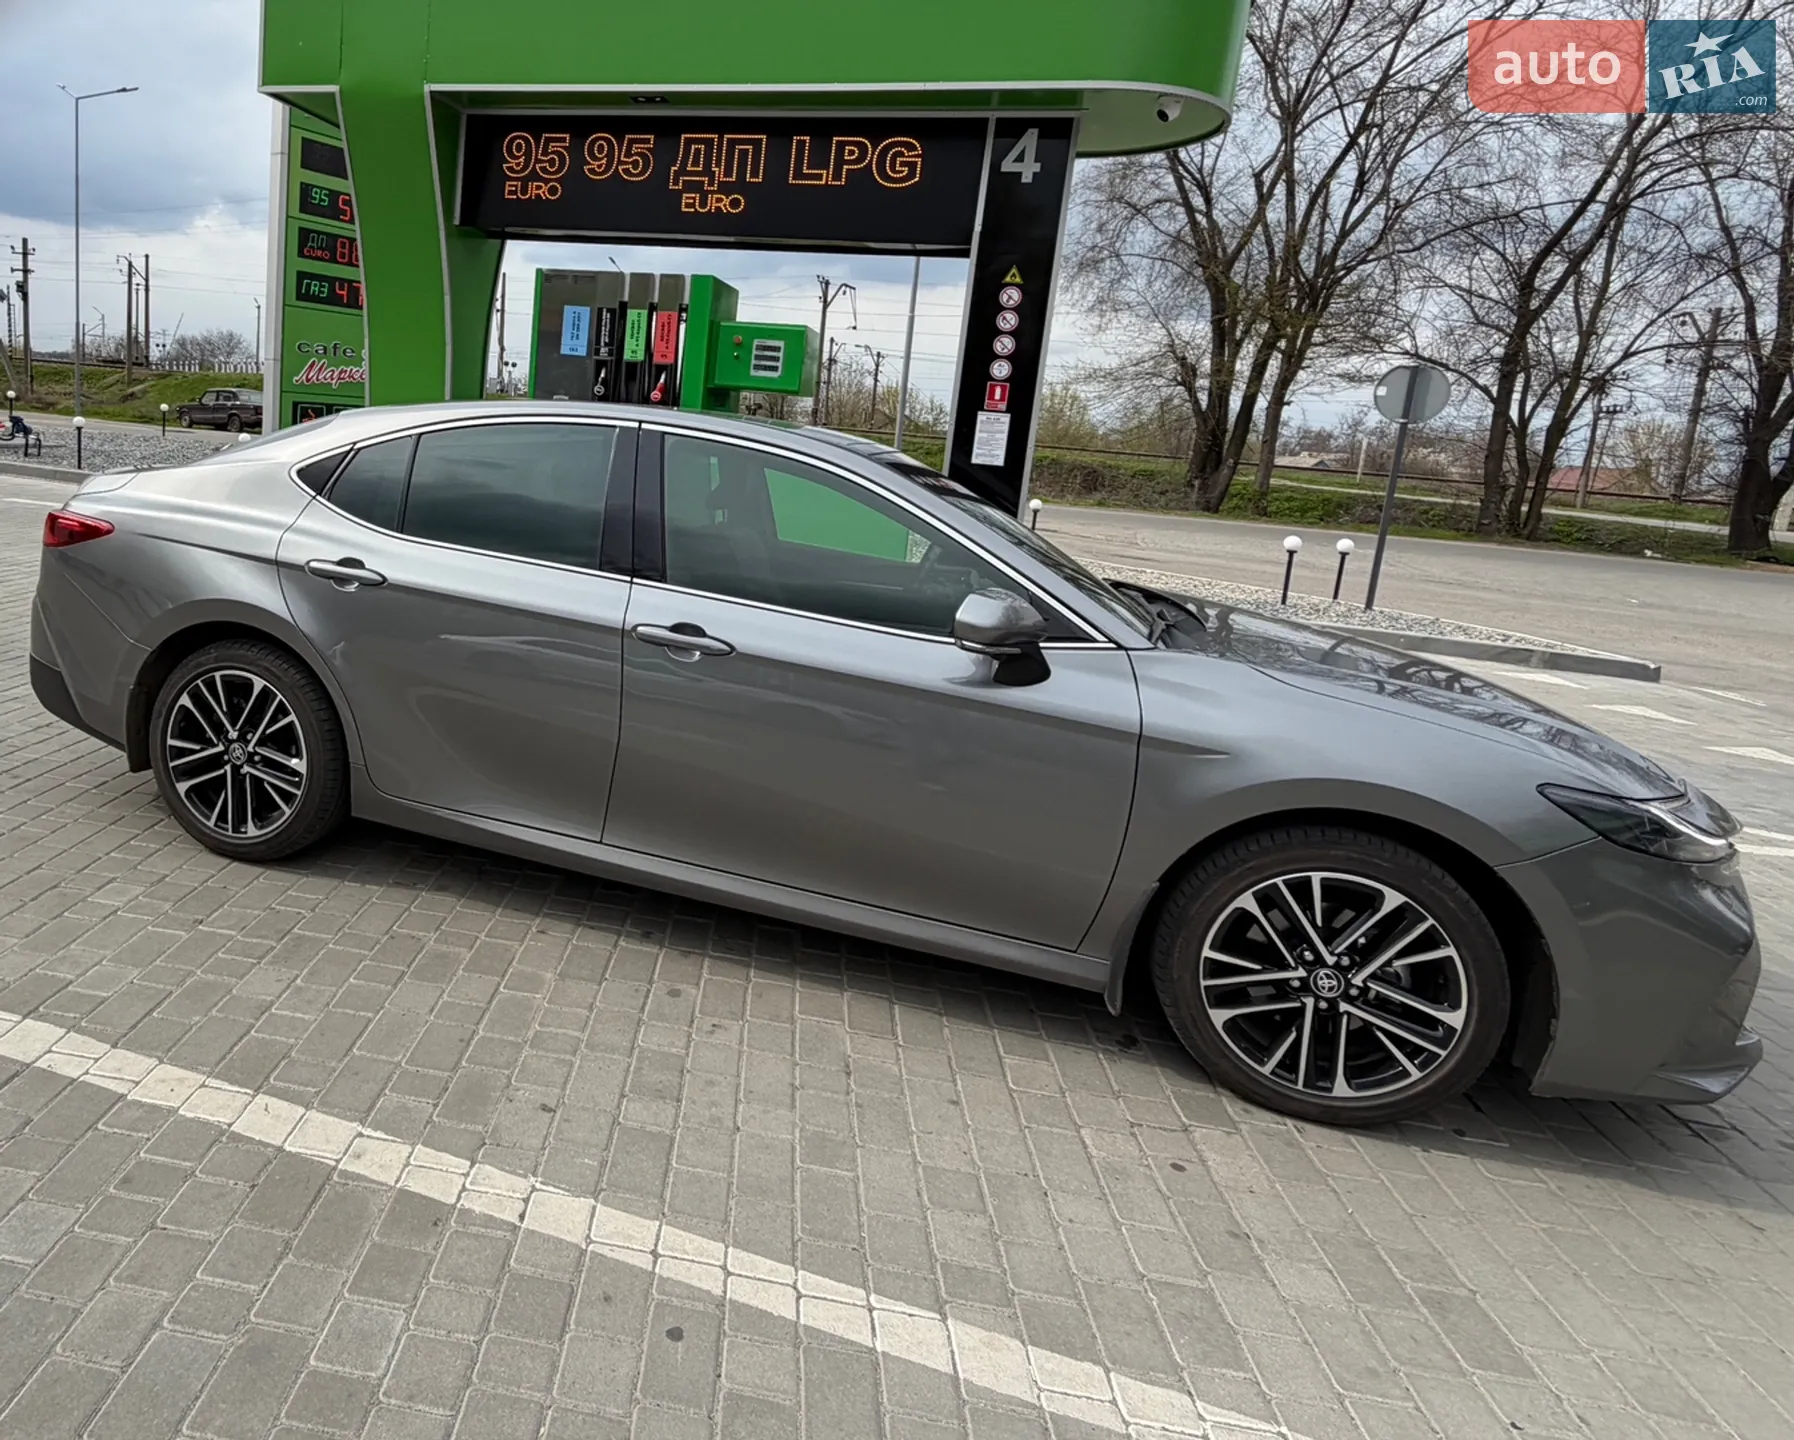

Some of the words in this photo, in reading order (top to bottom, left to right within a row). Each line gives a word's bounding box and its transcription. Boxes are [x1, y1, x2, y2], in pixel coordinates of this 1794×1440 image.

[503, 132, 570, 179] 95
[584, 133, 655, 181] 95
[669, 134, 767, 191] ДП
[789, 136, 922, 188] LPG
[1001, 127, 1042, 184] 4
[311, 187, 329, 206] 95
[504, 181, 562, 200] EURO
[681, 193, 745, 213] EURO
[307, 233, 326, 248] ДП
[301, 279, 329, 297] ГАЗ
[296, 341, 356, 359] cafe
